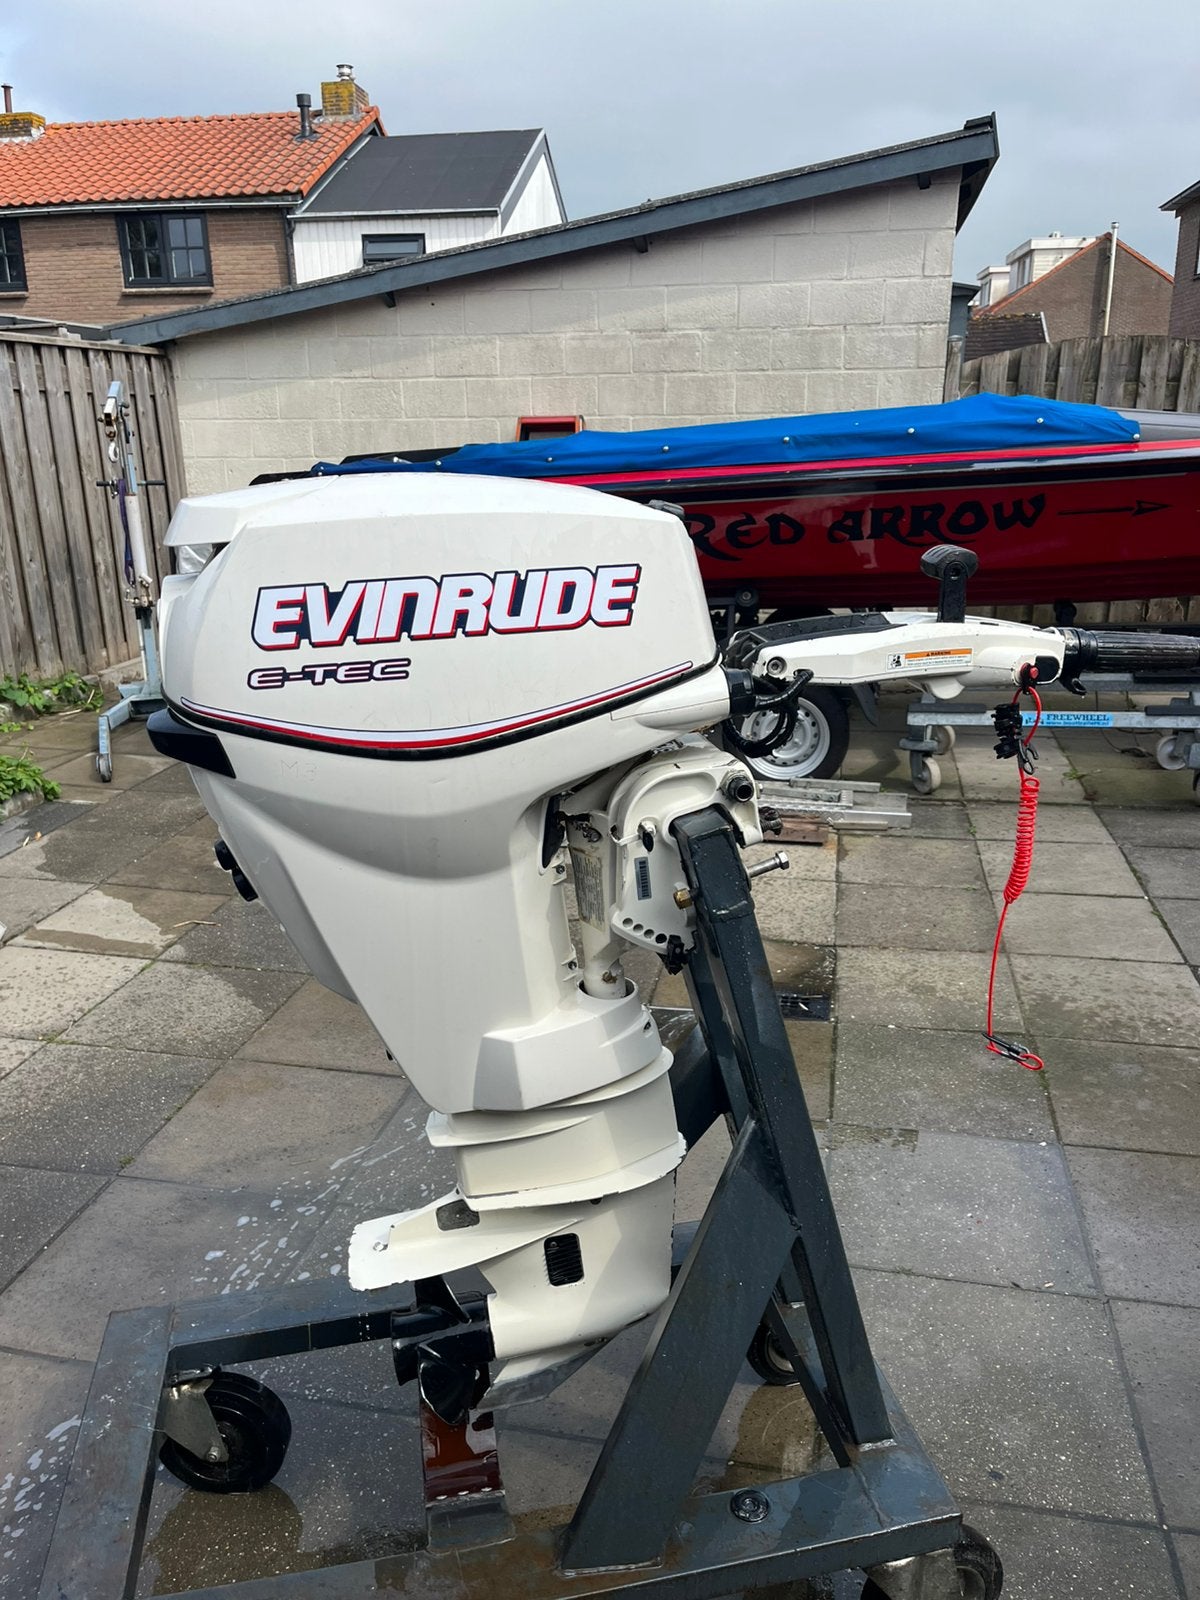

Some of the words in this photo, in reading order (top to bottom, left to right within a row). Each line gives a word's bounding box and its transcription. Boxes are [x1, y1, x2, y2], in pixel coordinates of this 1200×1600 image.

[684, 512, 805, 561] RED
[828, 494, 1045, 547] ARROW
[252, 564, 641, 651] EVINRUDE
[248, 658, 411, 690] E-TEC
[1046, 713, 1110, 721] FREEWHEEL
